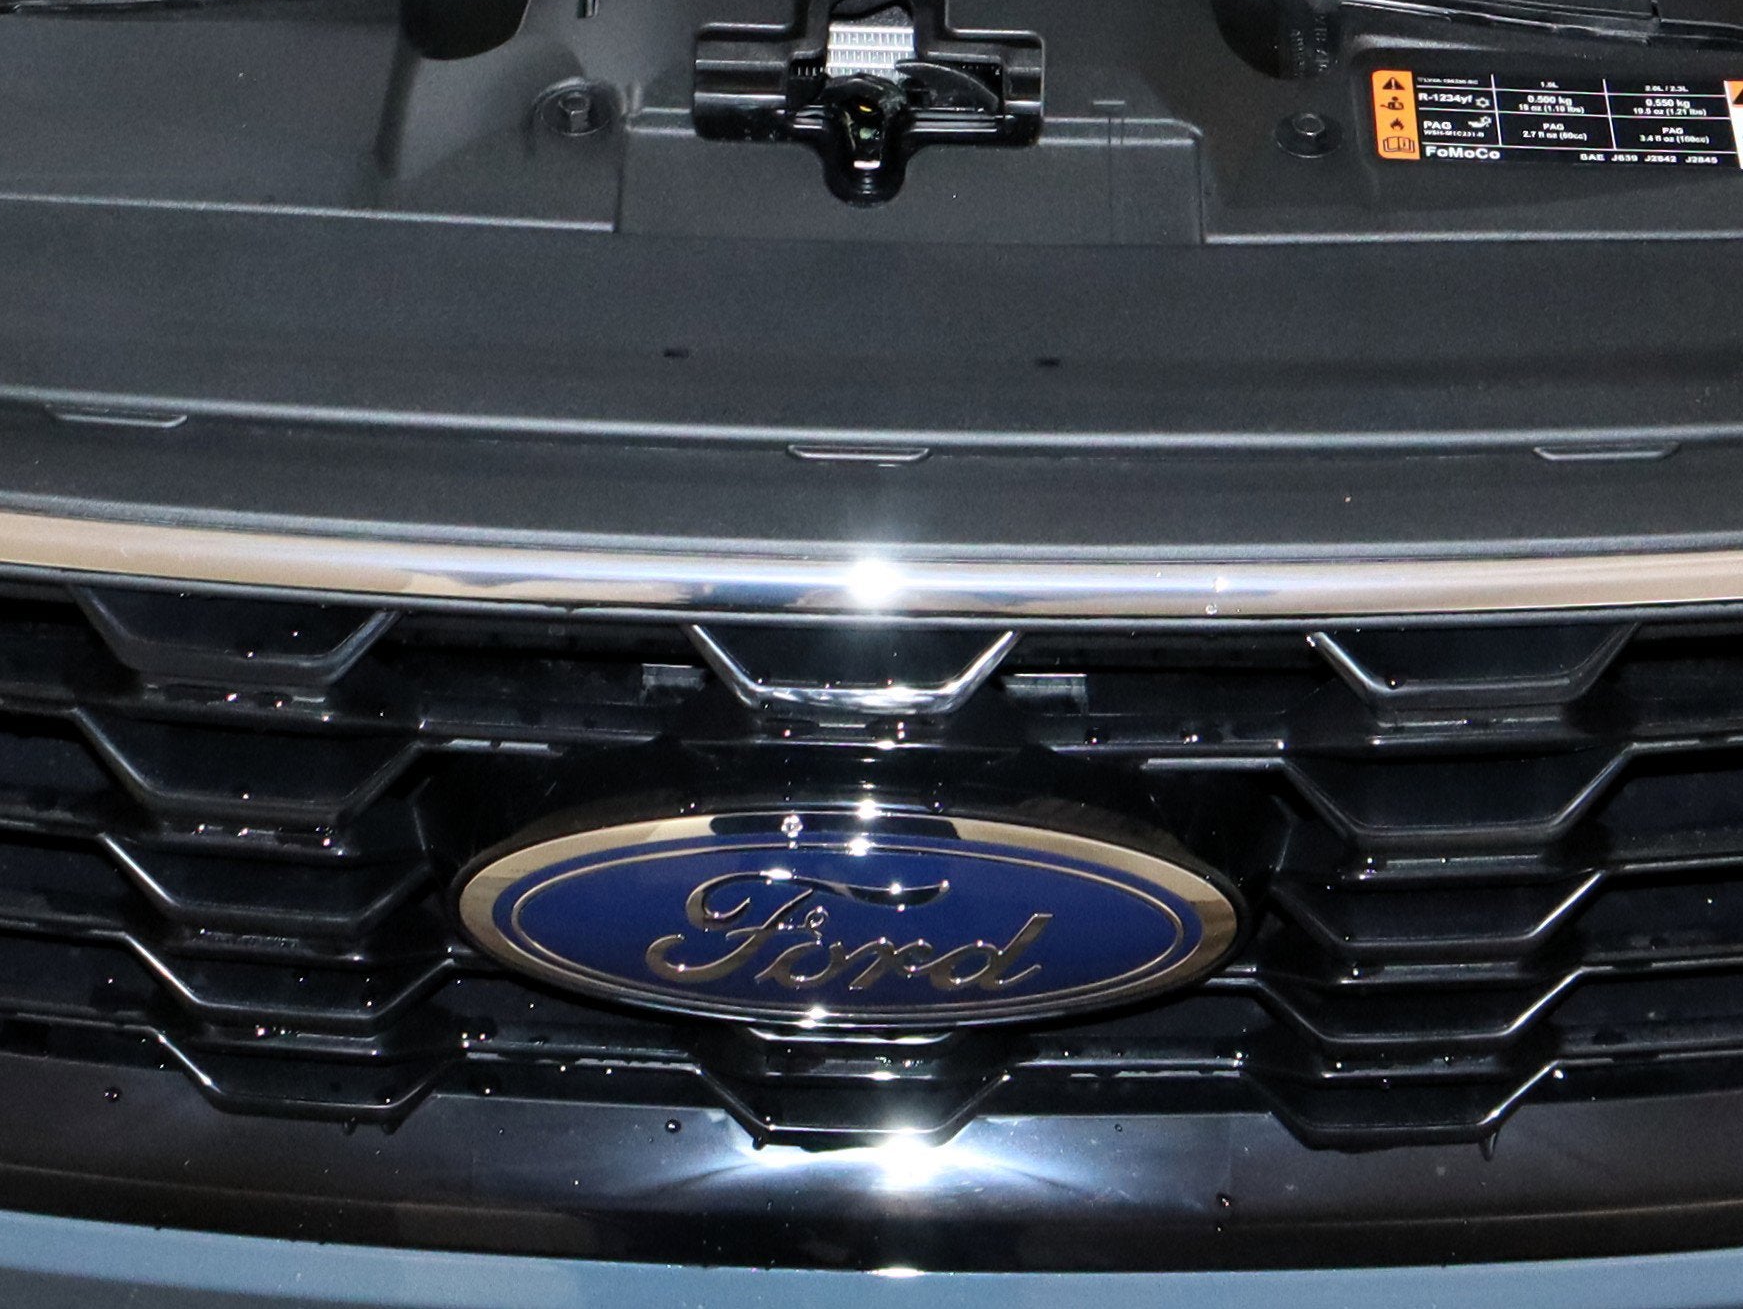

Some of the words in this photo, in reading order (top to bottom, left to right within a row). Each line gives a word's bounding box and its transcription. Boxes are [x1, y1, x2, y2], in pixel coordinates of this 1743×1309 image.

[1418, 92, 1473, 104] R-1234yf
[1527, 95, 1556, 104] 0.500
[1558, 96, 1573, 106] kg
[1676, 99, 1690, 109] kg
[1666, 108, 1687, 116] (1.21
[1423, 120, 1452, 130] PAG
[1542, 123, 1565, 131] PAG
[1522, 130, 1537, 138] 2.7
[1425, 146, 1501, 160] FoMoCo
[1580, 153, 1606, 161] SAE
[1611, 154, 1638, 162] J639
[646, 868, 1053, 991] Ford
